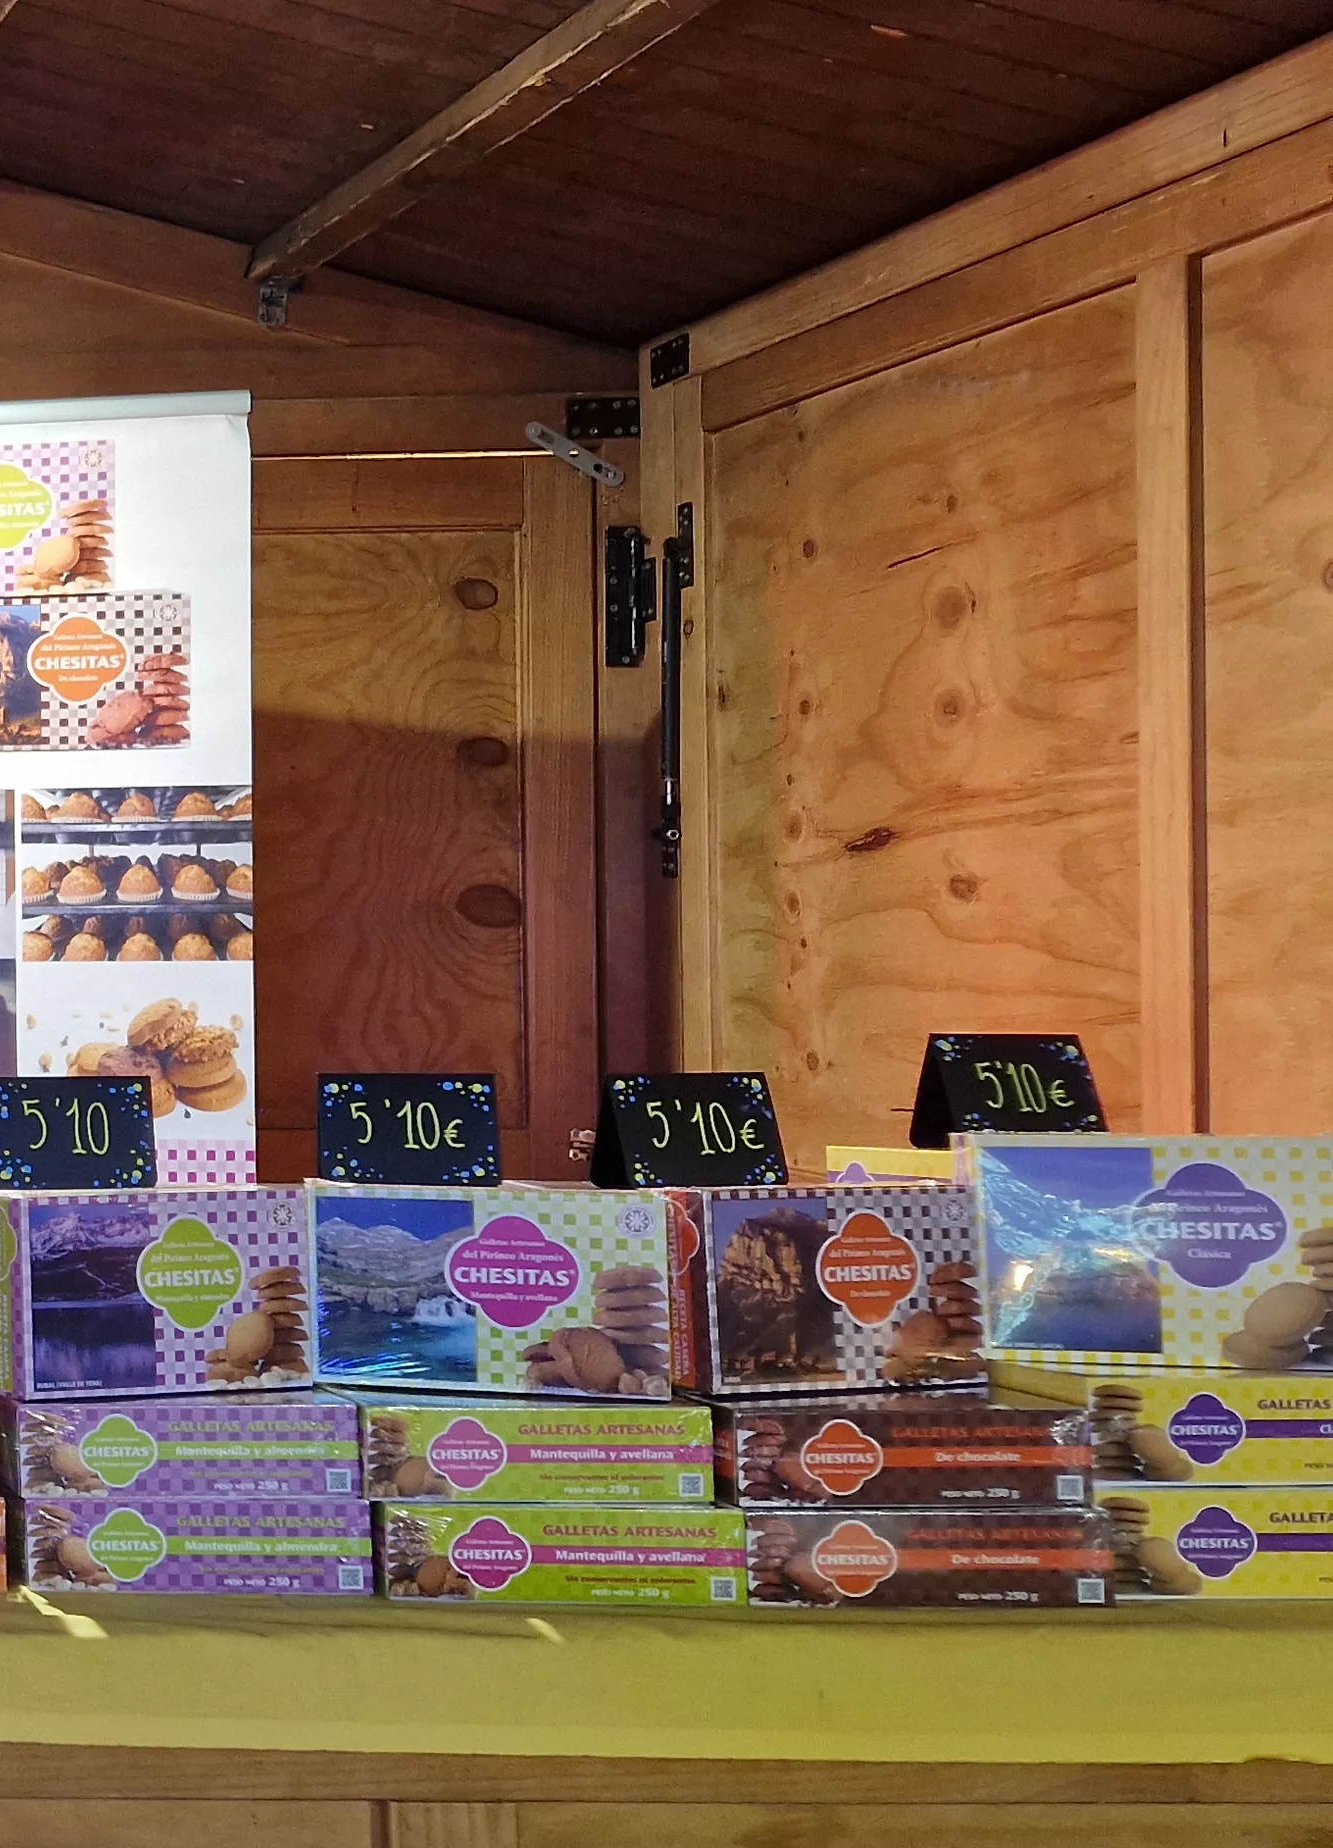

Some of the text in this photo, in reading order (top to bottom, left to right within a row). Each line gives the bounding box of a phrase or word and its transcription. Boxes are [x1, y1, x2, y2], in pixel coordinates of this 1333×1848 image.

[22, 1097, 110, 1155] 5'10
[1257, 1399, 1331, 1410] GALLETAS
[518, 1424, 686, 1436] GALLETAS ARTESANAS
[530, 1449, 674, 1462] Mantequilla y avellana
[936, 1451, 1022, 1462] De chocolate
[542, 1524, 717, 1538] GALLETAS ARTESANAS
[185, 1540, 338, 1553] Mantequilla y almendra
[555, 1549, 704, 1563] Mantequilla y avellana
[952, 1554, 1040, 1564] De chocolate
